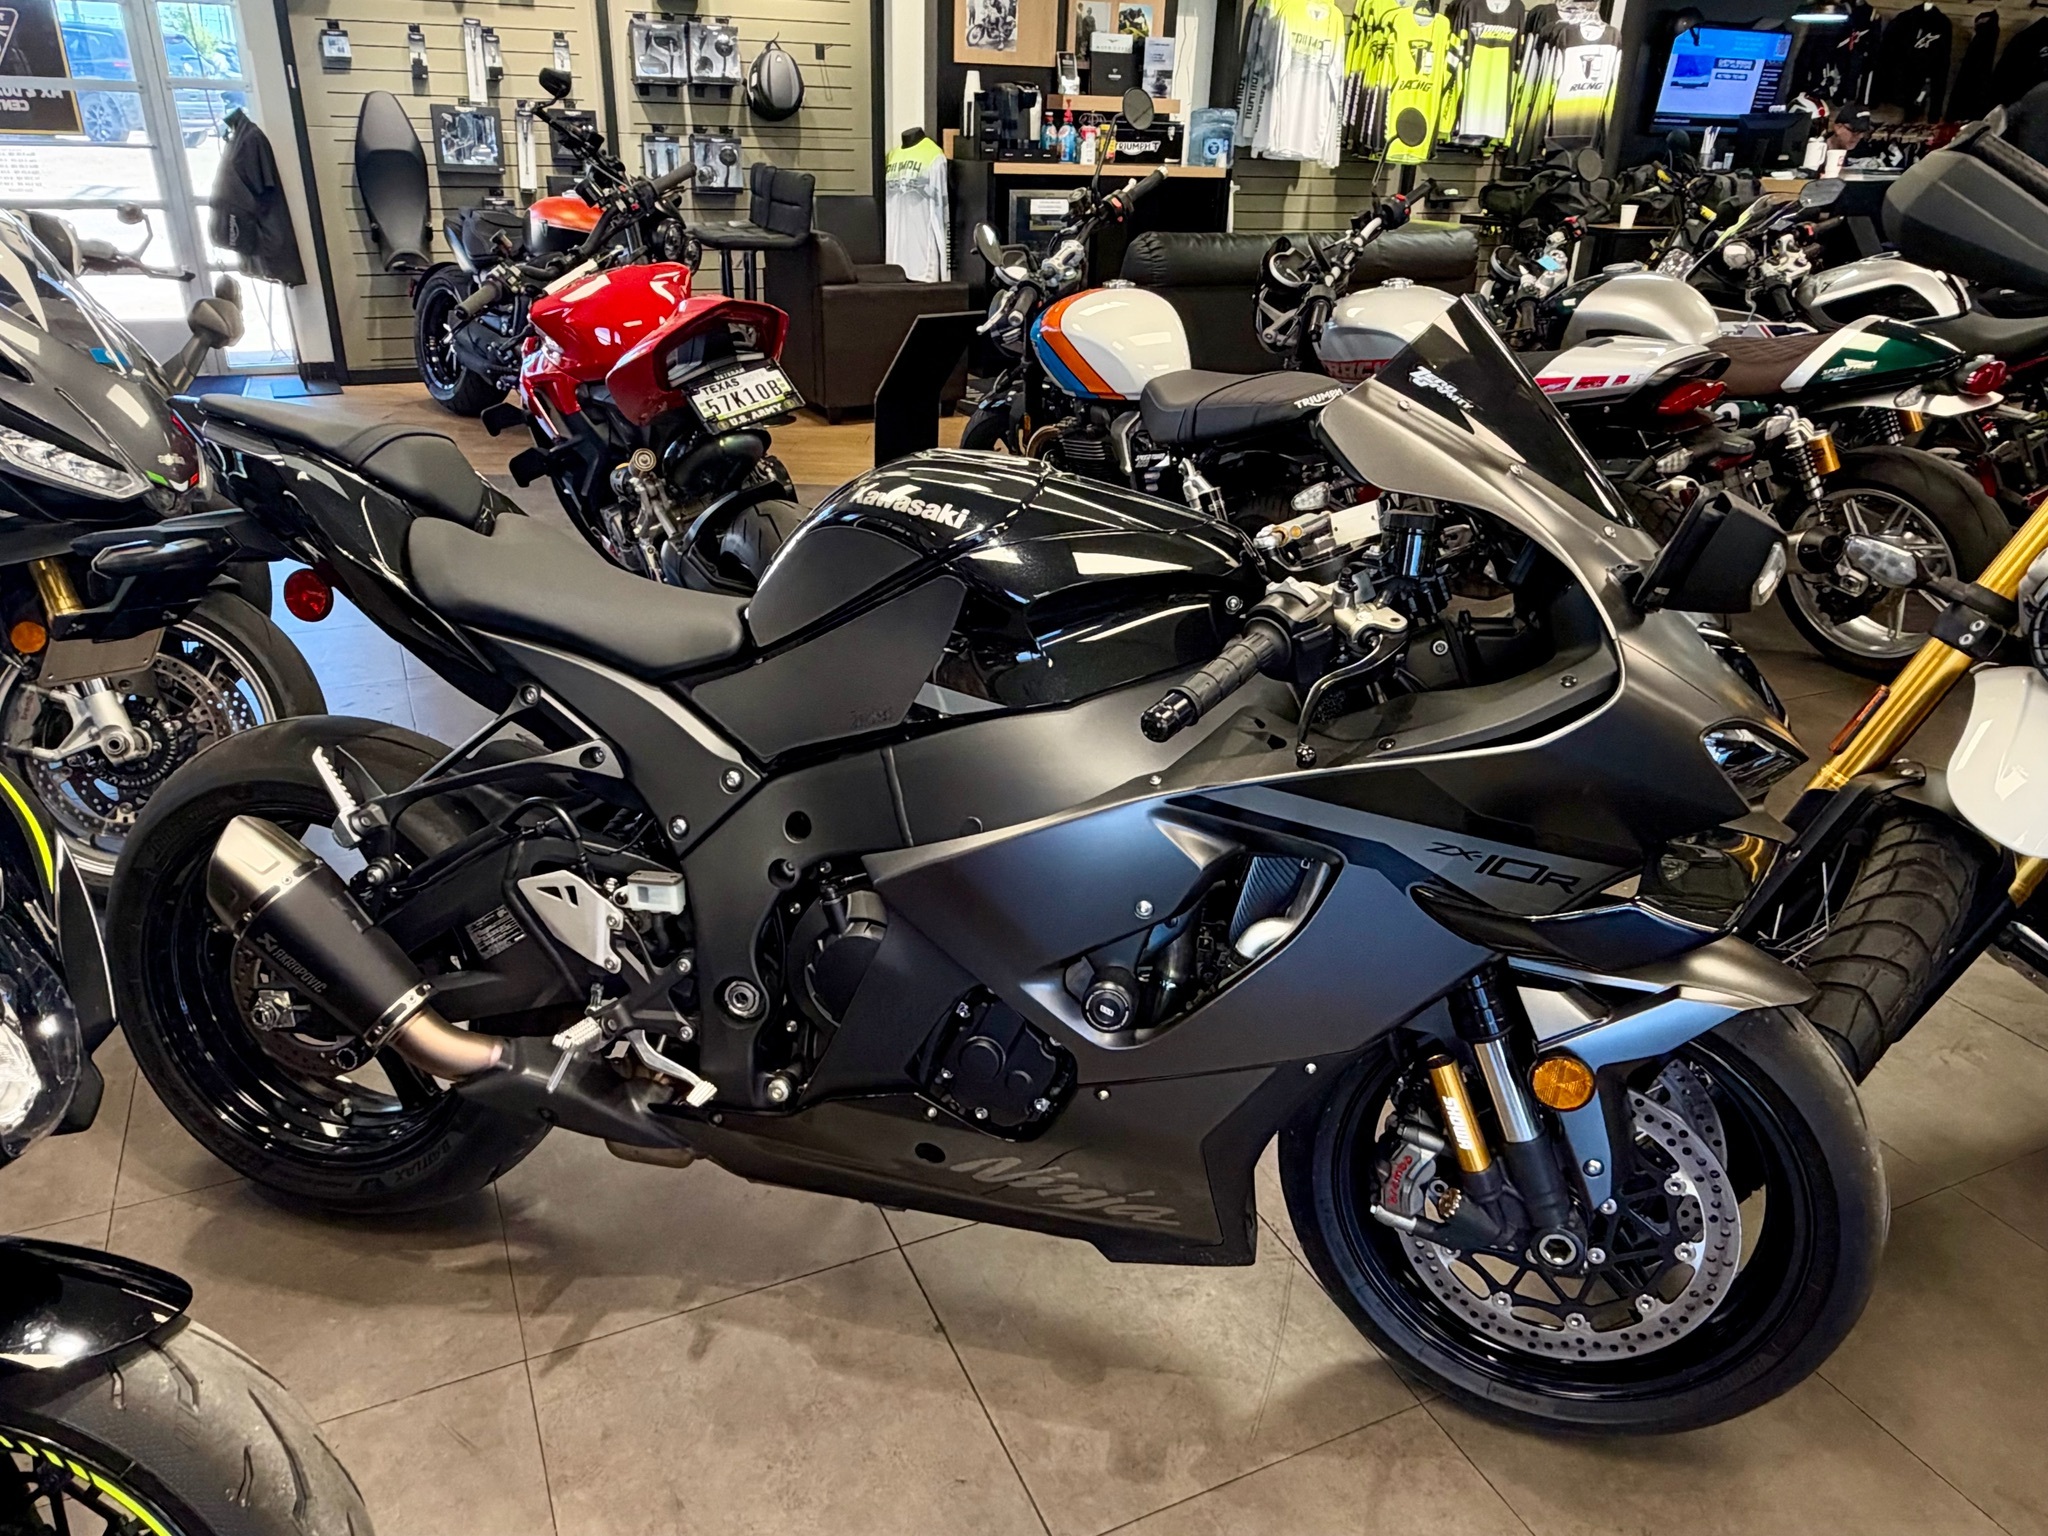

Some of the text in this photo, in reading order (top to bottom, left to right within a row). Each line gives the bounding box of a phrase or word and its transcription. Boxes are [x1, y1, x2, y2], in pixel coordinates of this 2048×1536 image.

[701, 378, 740, 395] TEXAS
[705, 379, 783, 417] 57K10B
[1294, 387, 1344, 409] TRIUMPH
[729, 403, 783, 426] U.S. ARMY
[849, 482, 970, 529] Kawasaki
[1425, 841, 1581, 894] ZX-10R
[1442, 1095, 1473, 1150] SHOWA
[949, 1156, 1181, 1226] Ninja
[1388, 1155, 1413, 1205] brembo
